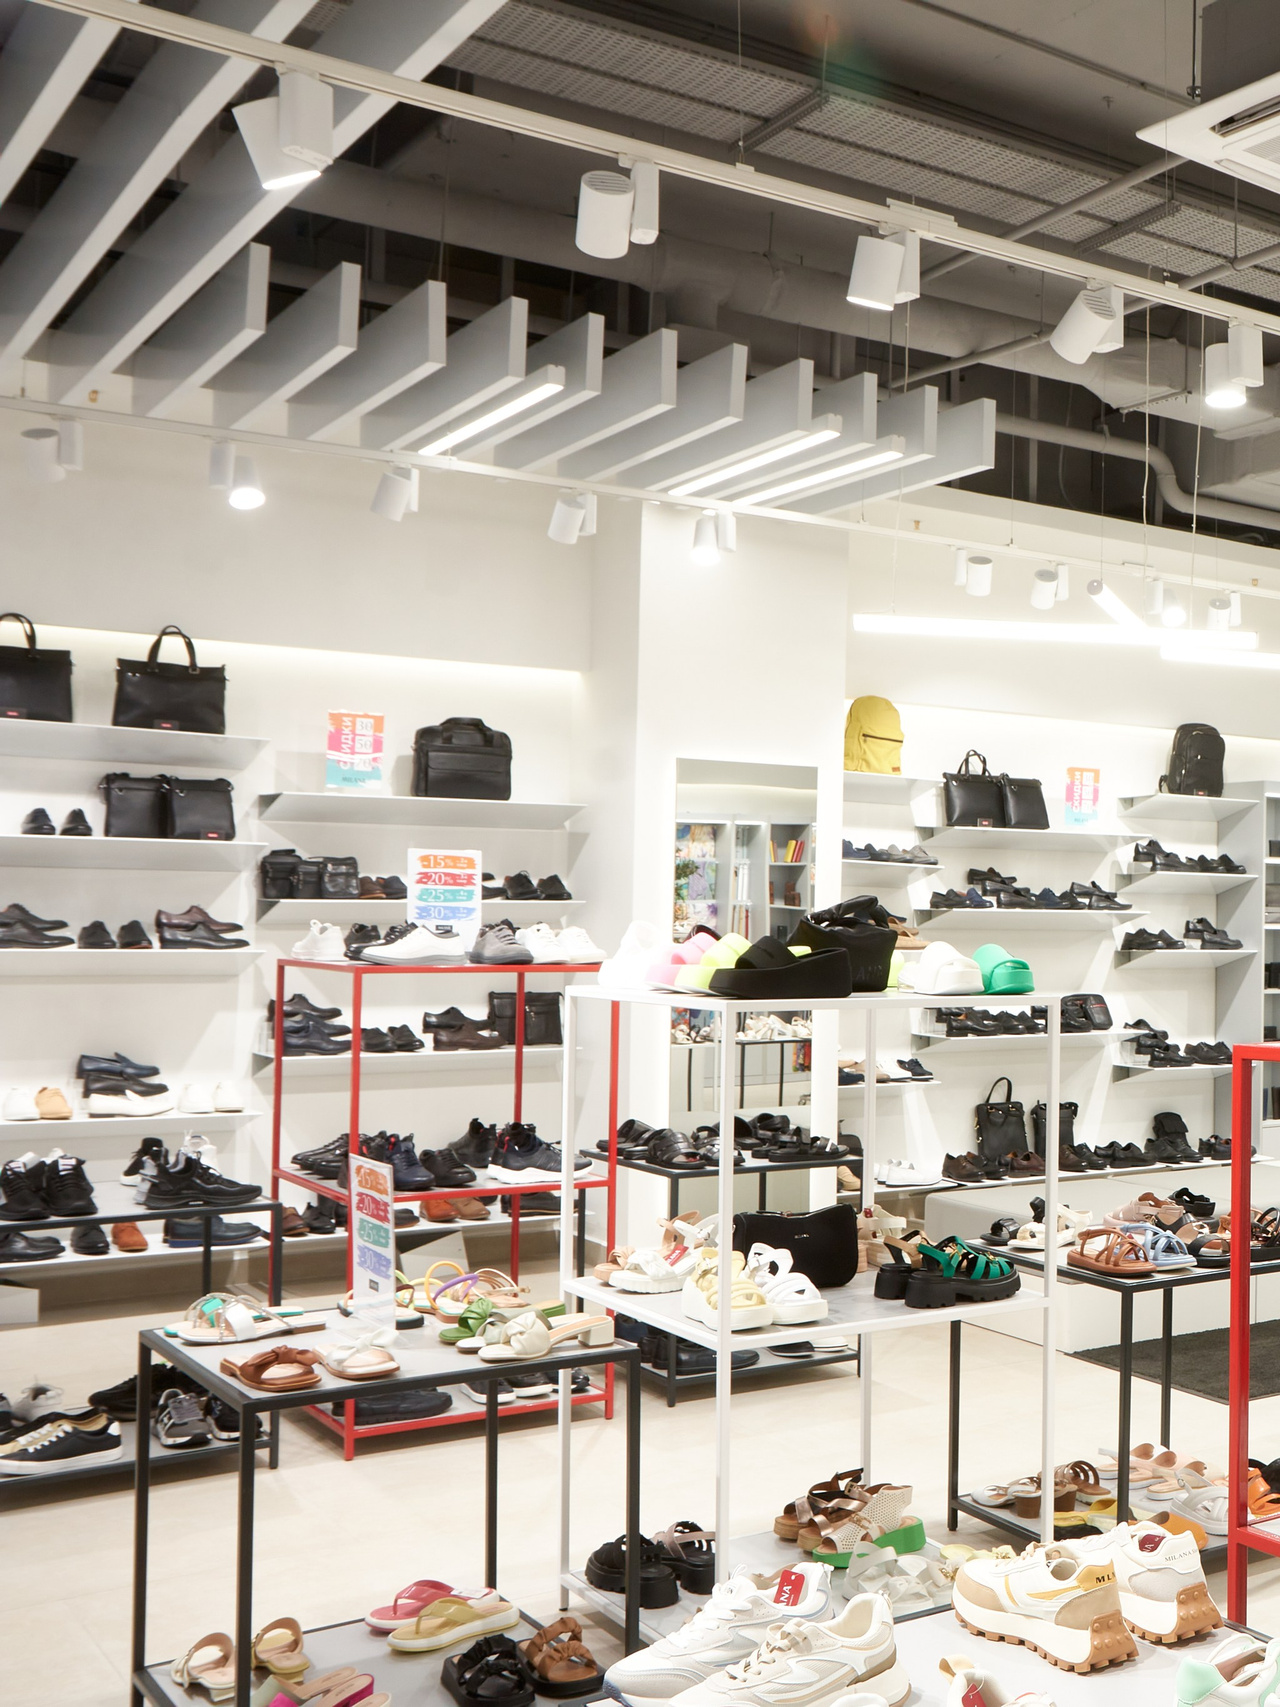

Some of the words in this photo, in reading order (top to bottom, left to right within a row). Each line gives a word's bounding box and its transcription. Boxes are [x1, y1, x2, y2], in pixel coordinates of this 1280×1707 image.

[339, 717, 354, 770] СИДКИ
[356, 738, 372, 751] 50
[1164, 1551, 1192, 1563] MILANA
